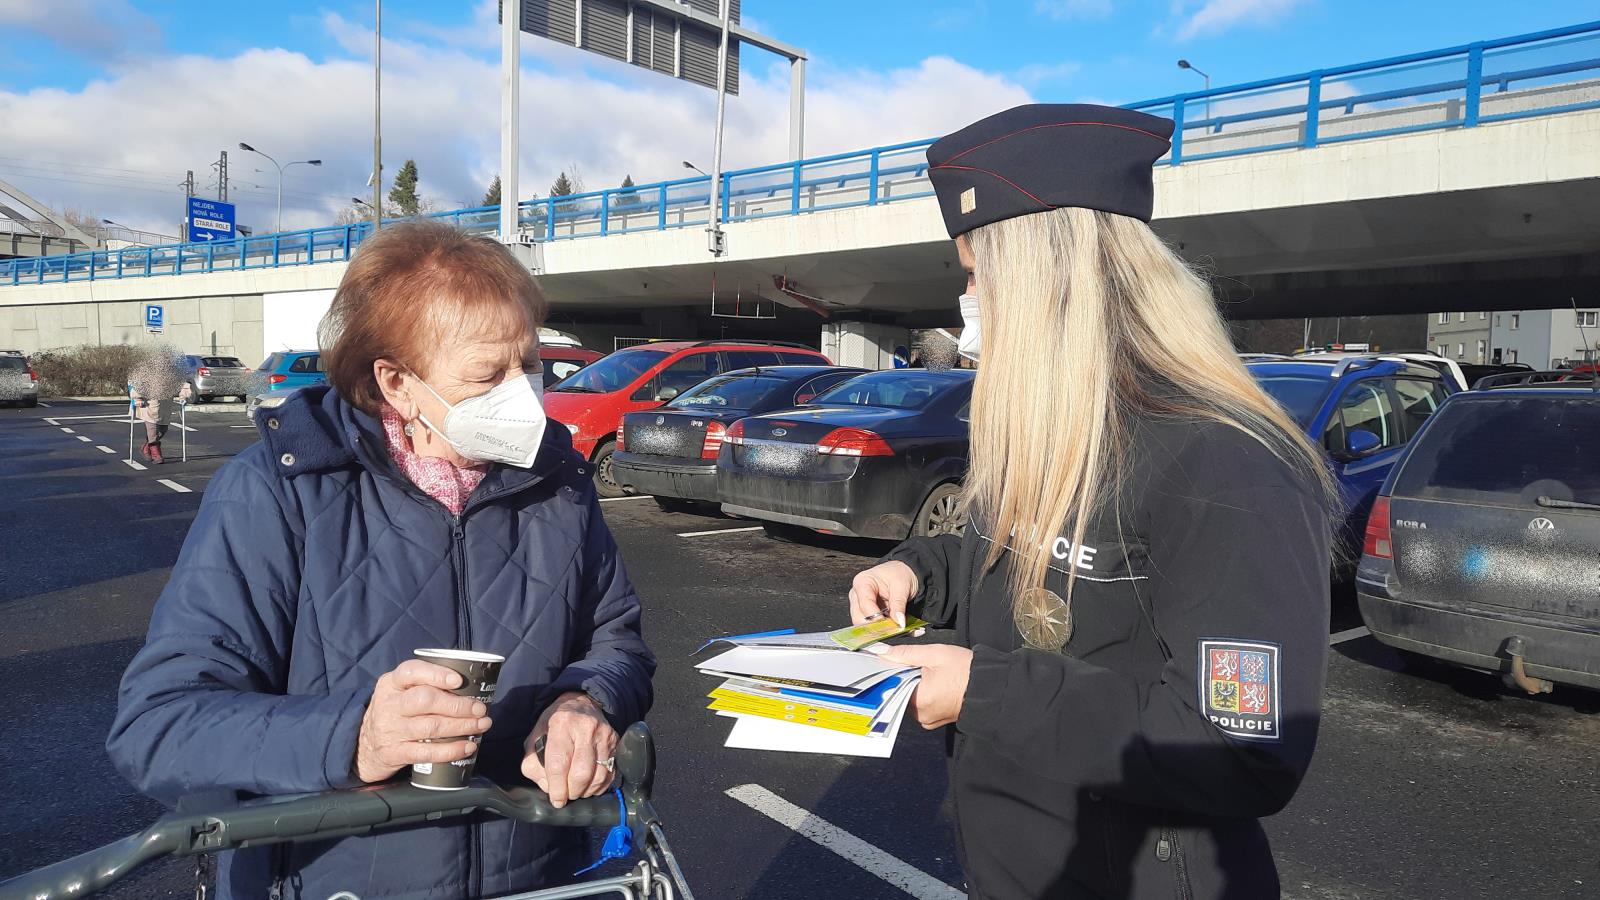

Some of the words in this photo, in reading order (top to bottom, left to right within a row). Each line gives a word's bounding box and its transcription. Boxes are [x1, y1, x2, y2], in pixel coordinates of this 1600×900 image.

[192, 201, 215, 210] NEJDEK
[195, 219, 214, 228] STARÁ
[215, 222, 230, 230] ROLE
[149, 307, 160, 321] P
[1396, 519, 1427, 529] BORA
[1209, 715, 1273, 731] POLICIE
